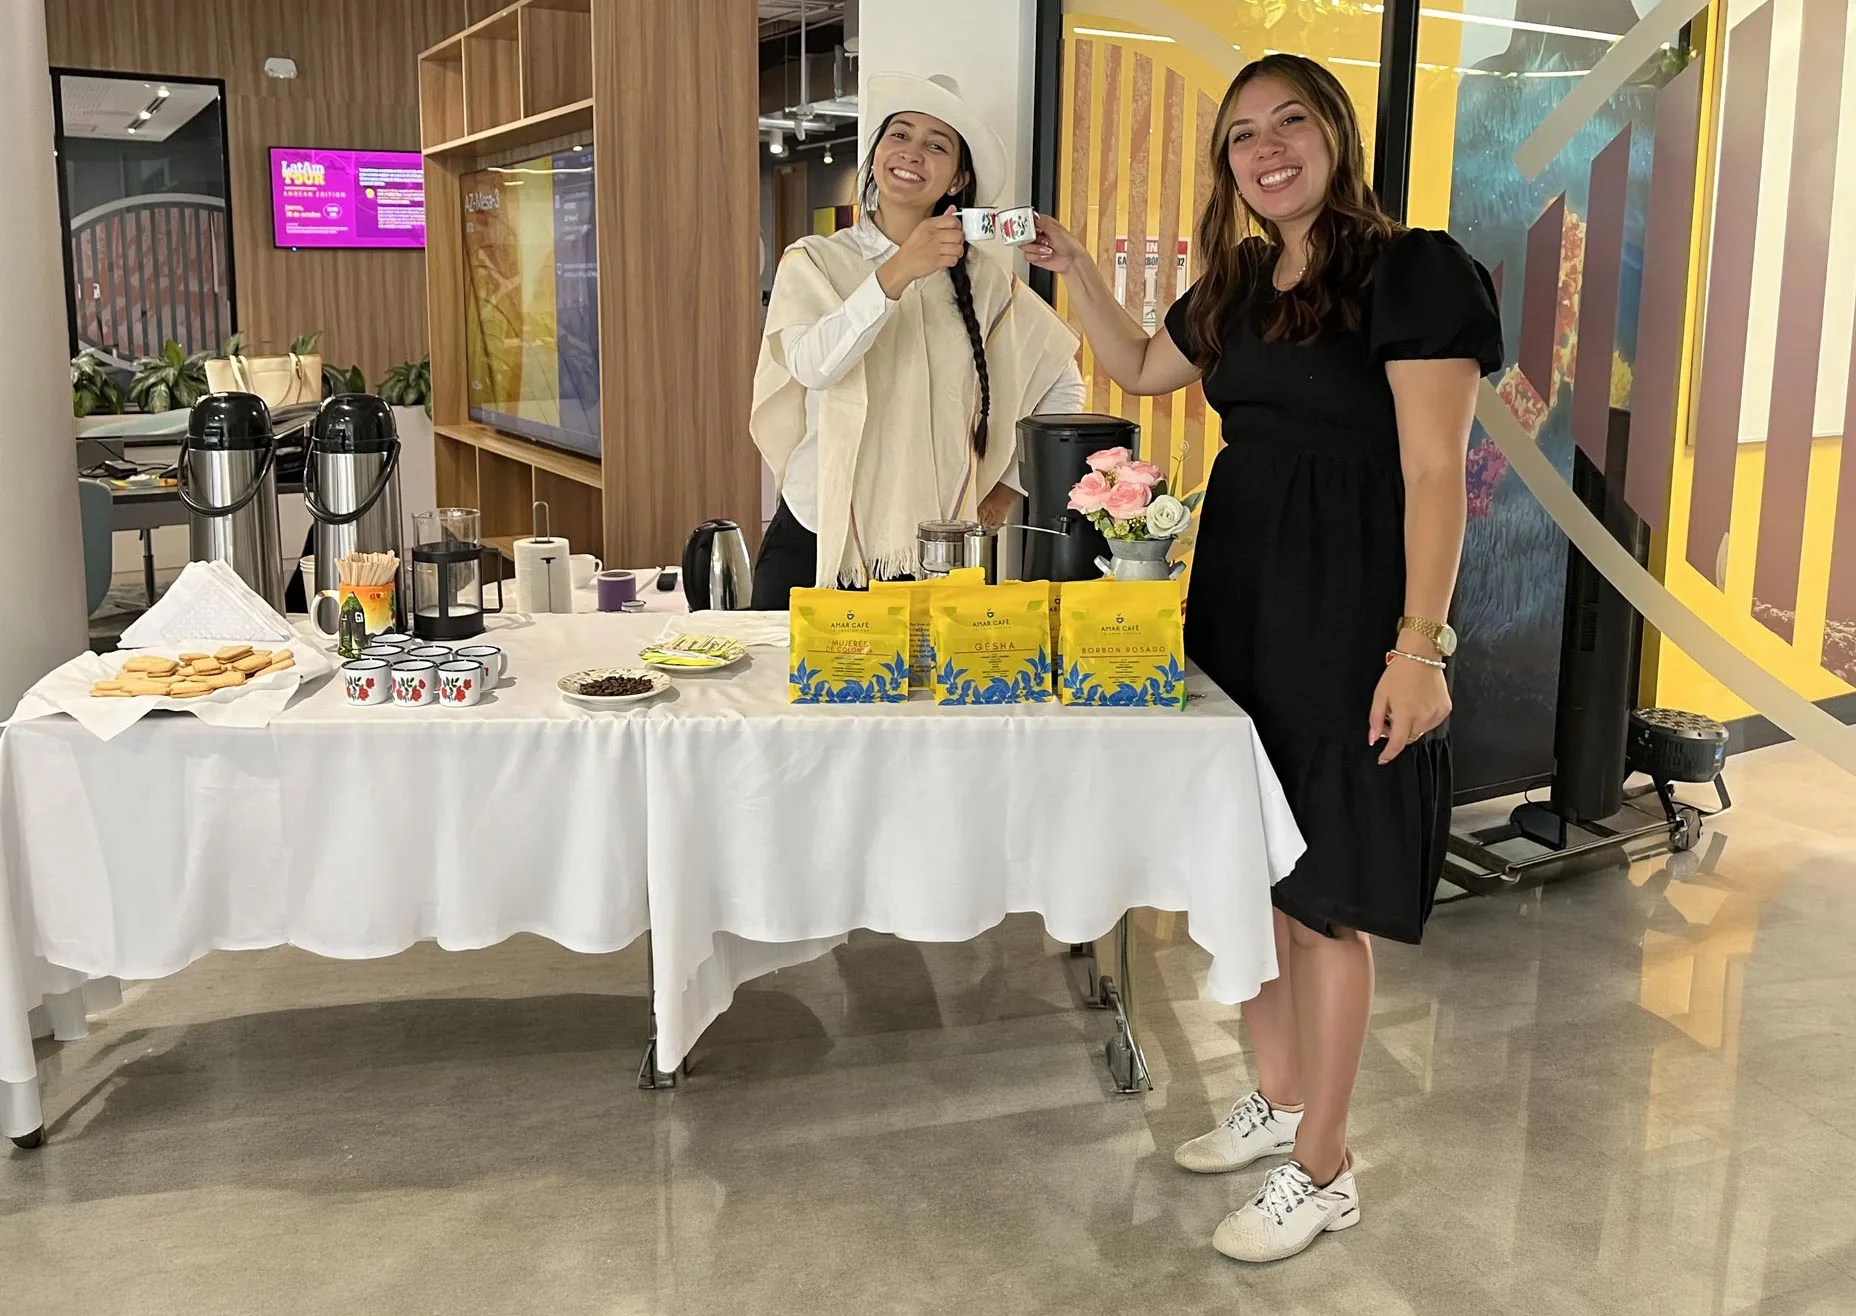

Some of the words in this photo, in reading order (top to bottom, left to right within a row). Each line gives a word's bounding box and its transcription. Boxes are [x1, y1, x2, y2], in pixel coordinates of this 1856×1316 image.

[281, 161, 325, 174] LatAm
[284, 172, 326, 185] TOUR
[851, 621, 869, 629] CAFÉ
[972, 620, 991, 628] AMAR
[993, 618, 1010, 626] CAFÉ
[1122, 624, 1140, 632] CAFÉ
[837, 646, 873, 654] COLOMA
[974, 641, 1016, 651] GESHA
[1081, 646, 1121, 654] BORBON
